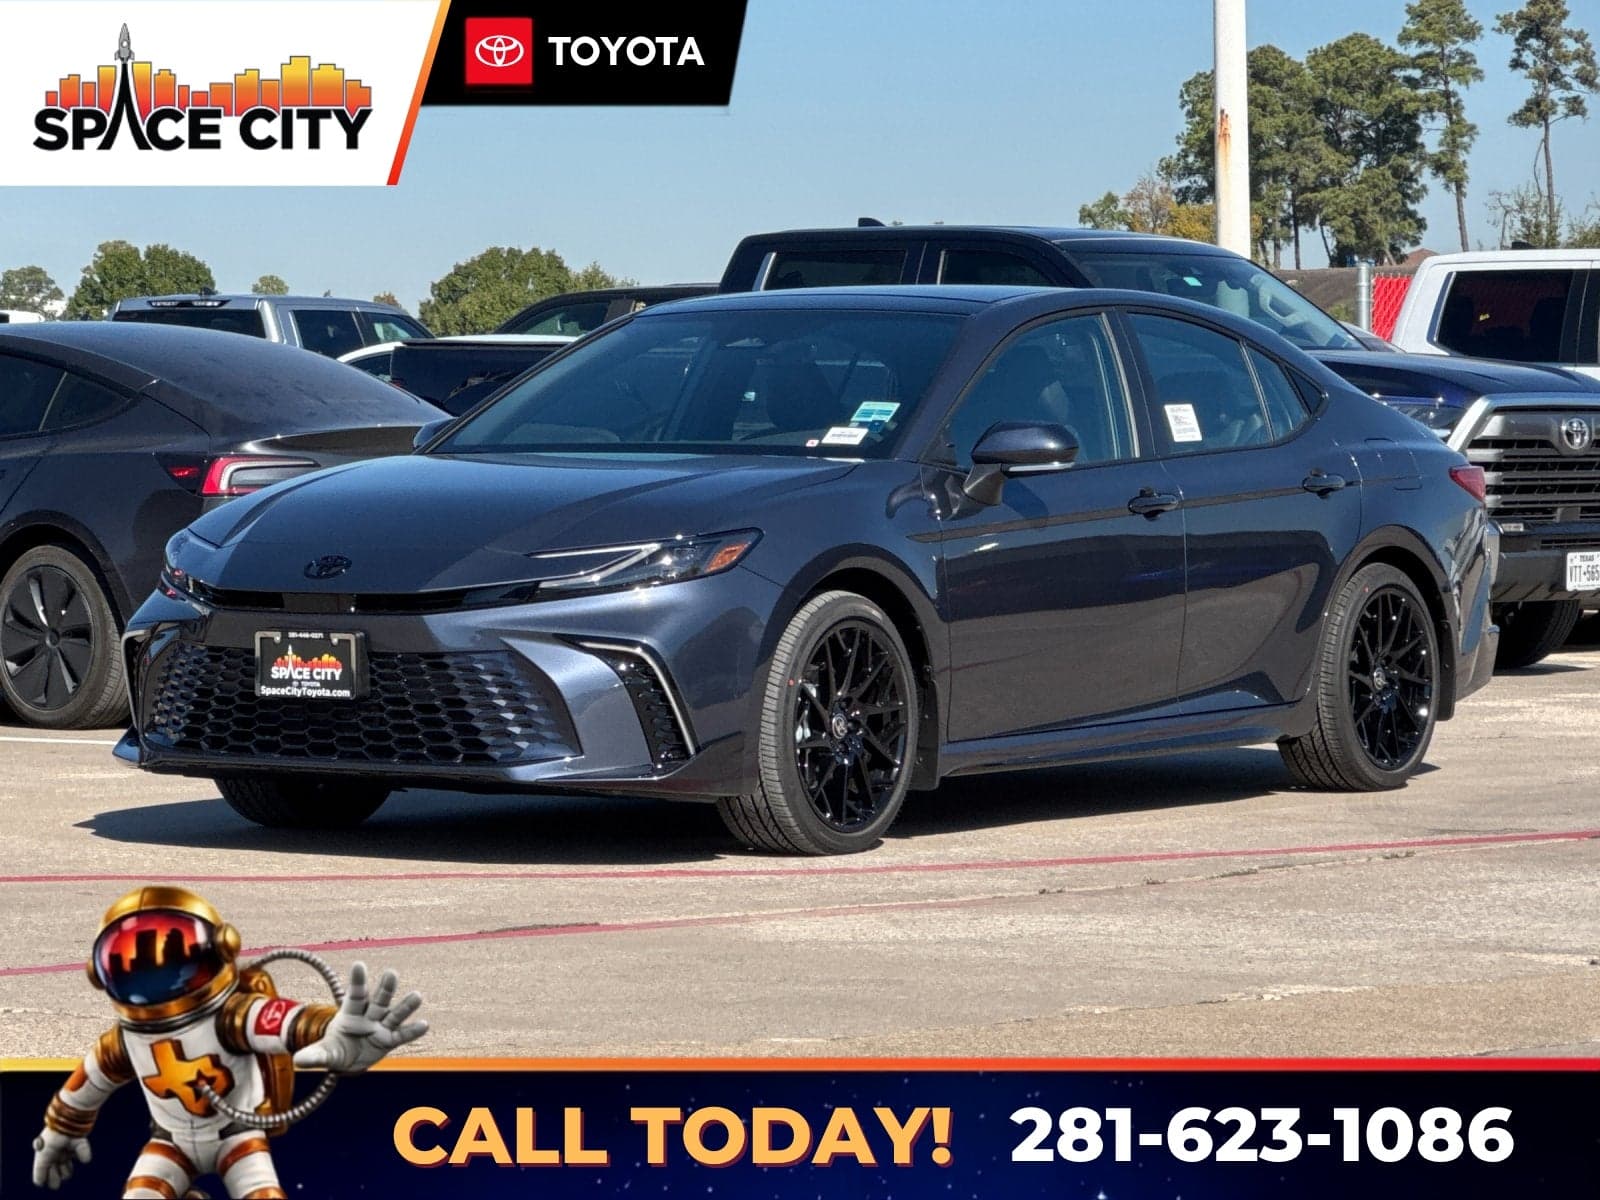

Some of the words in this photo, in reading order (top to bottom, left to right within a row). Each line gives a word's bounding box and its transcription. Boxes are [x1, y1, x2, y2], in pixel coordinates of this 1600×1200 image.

[270, 666, 310, 679] SPACE
[312, 667, 343, 680] CITY
[260, 686, 350, 697] SpaceCityToyota.com
